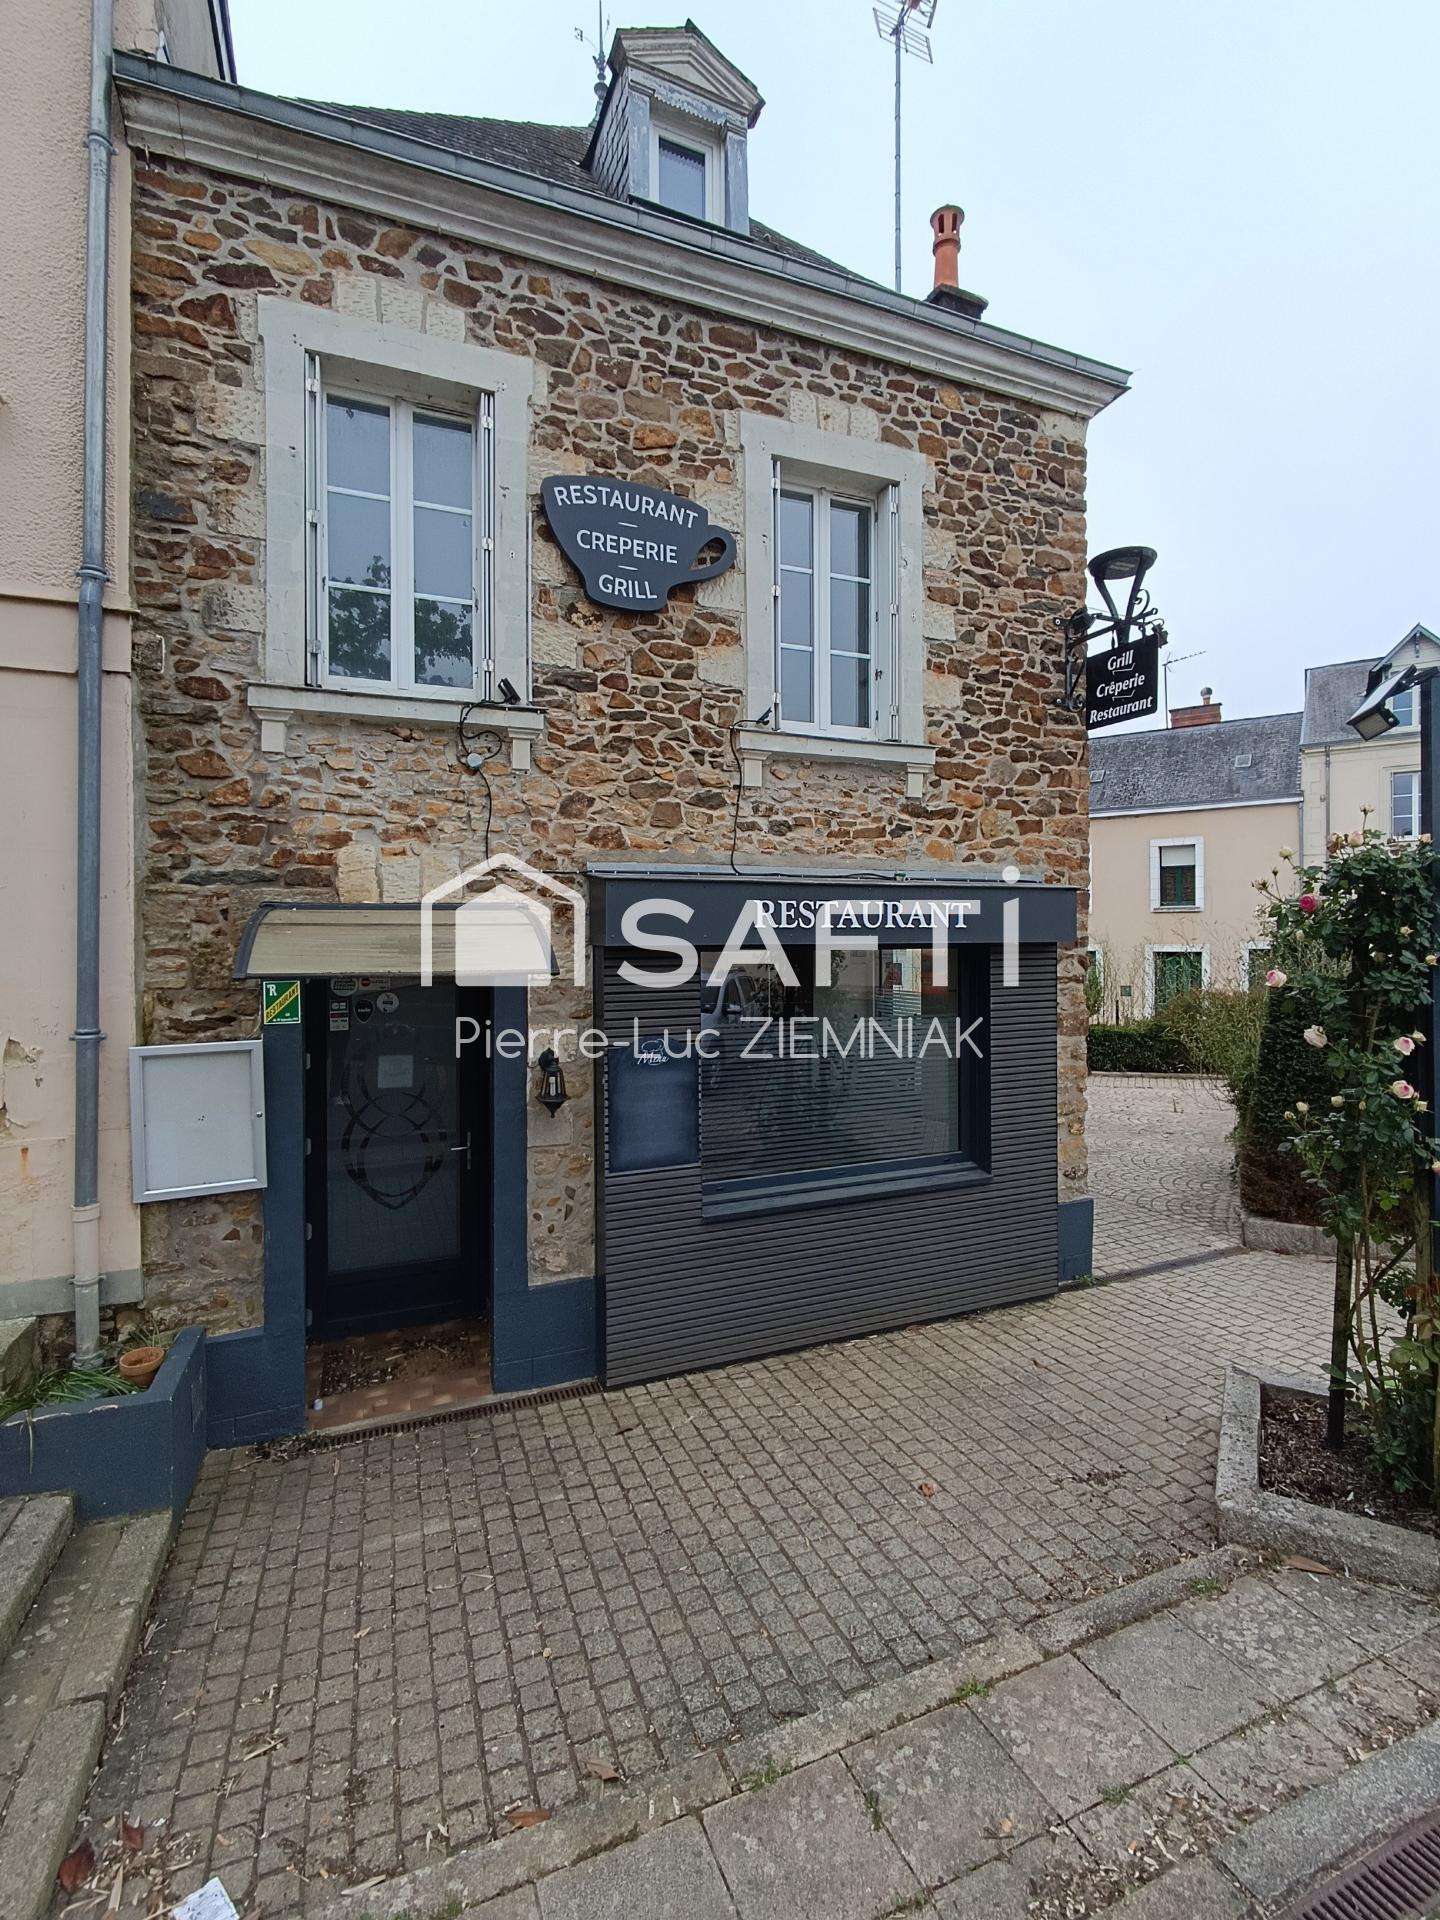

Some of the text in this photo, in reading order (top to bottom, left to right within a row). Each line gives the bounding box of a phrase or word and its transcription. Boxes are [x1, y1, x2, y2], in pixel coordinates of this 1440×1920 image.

[553, 485, 698, 528] RESTAURANT
[576, 529, 678, 564] CREPERIE
[598, 574, 658, 599] GRILL
[1107, 649, 1134, 671] Grill
[1096, 673, 1145, 698] Crêperie
[1089, 696, 1154, 724] Restaurant
[753, 899, 972, 929] RESTAURANT
